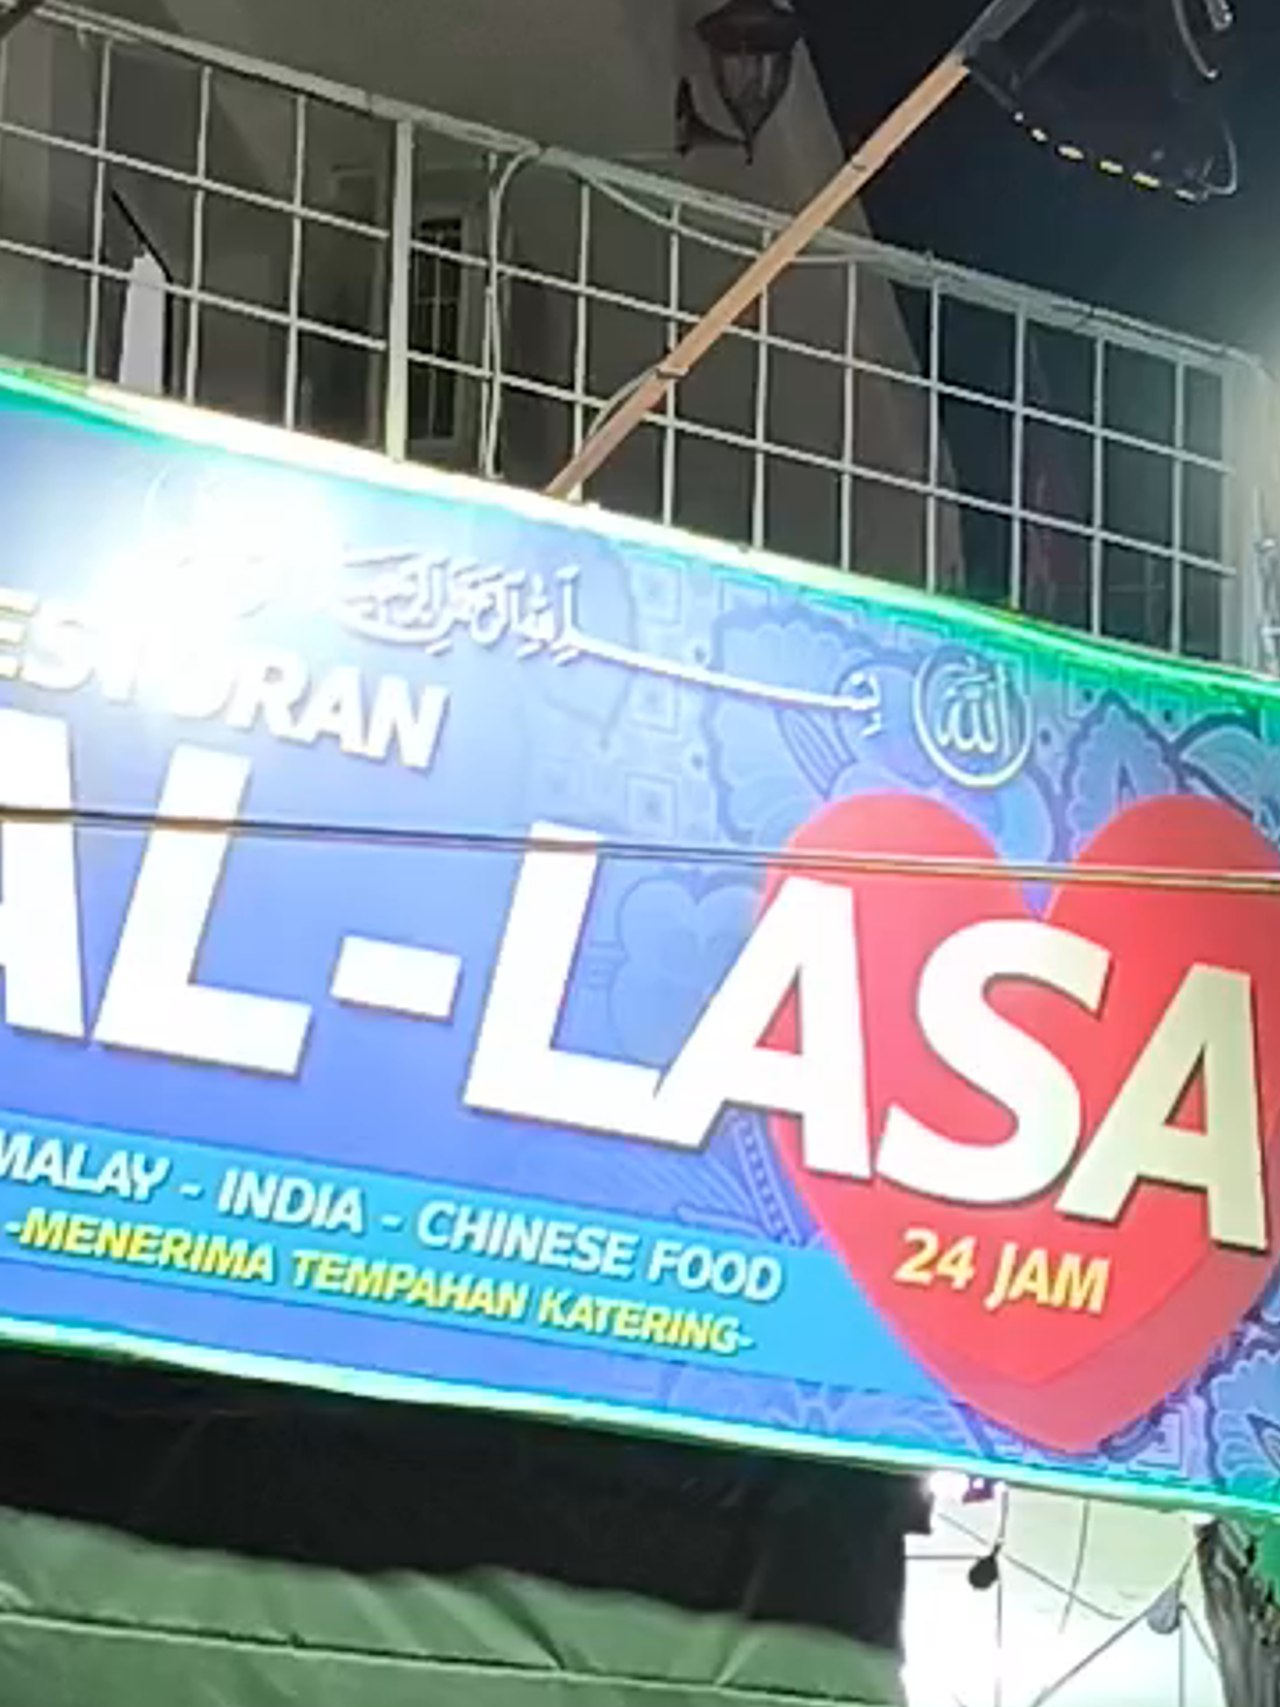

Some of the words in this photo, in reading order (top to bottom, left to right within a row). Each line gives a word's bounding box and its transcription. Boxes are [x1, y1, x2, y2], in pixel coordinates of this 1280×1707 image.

[3, 1207, 276, 1286] -MENERIMA
[291, 1250, 530, 1323] TEMPAHAN
[538, 1288, 756, 1357] KATERING-
[216, 1166, 367, 1237] INDIA
[416, 1200, 637, 1284] CHINESE
[647, 1239, 784, 1306] FOOD
[894, 1227, 976, 1291] 24
[982, 1251, 1111, 1315] JAM
